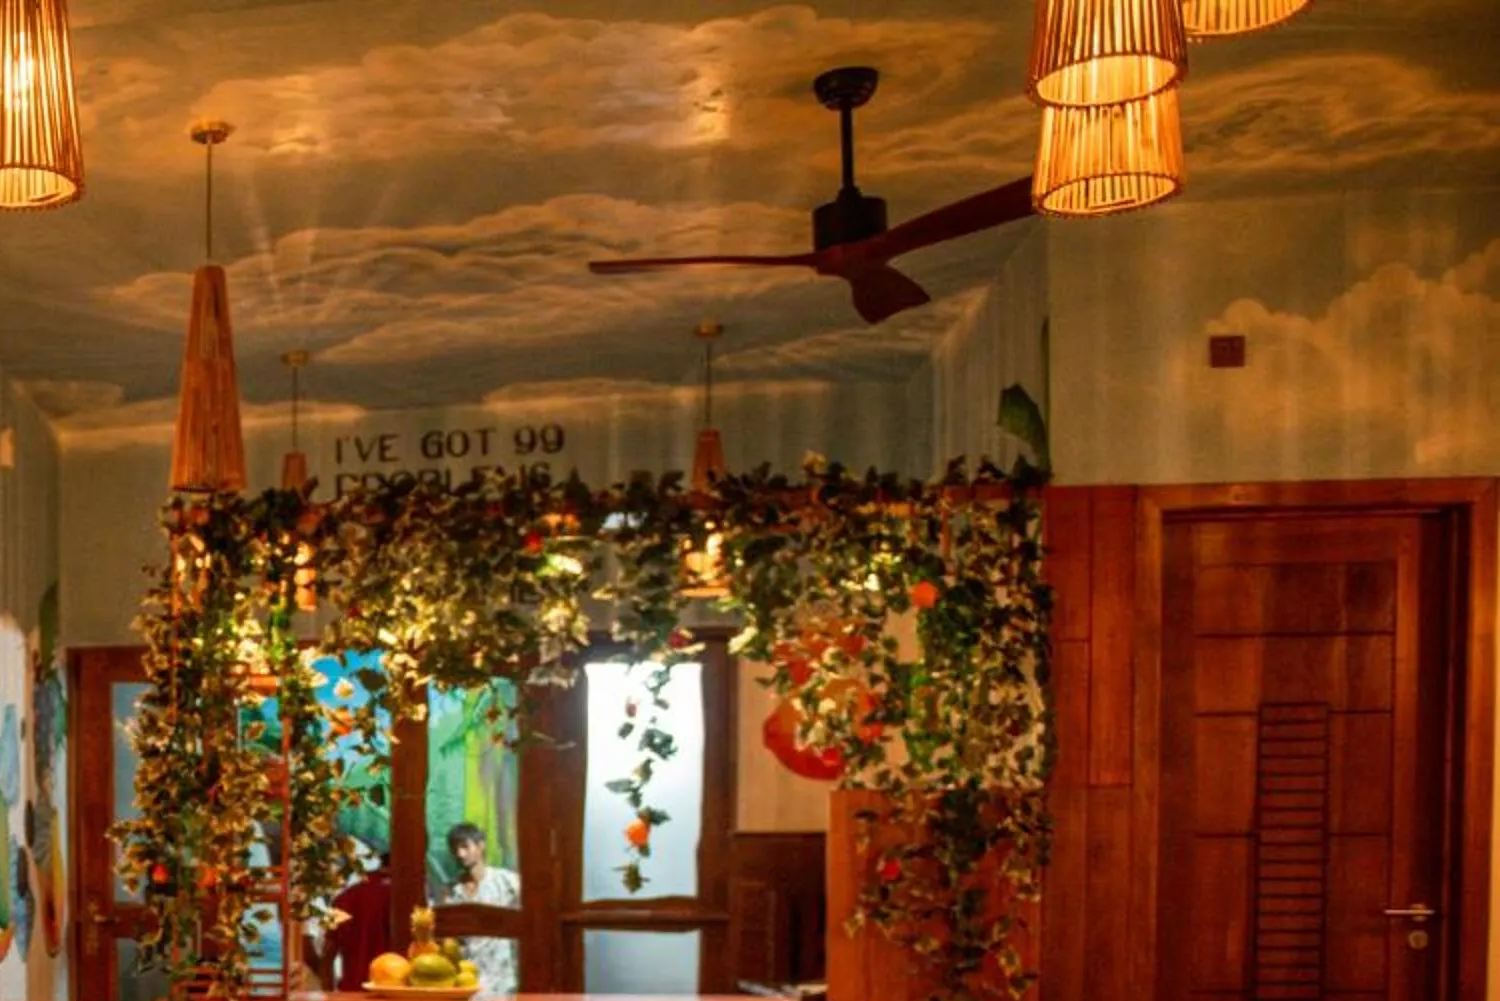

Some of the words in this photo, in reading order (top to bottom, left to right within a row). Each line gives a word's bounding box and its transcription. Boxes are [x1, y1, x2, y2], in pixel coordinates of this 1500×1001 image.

[334, 433, 399, 465] I'VE
[420, 427, 497, 460] GOT
[513, 423, 566, 455] 99
